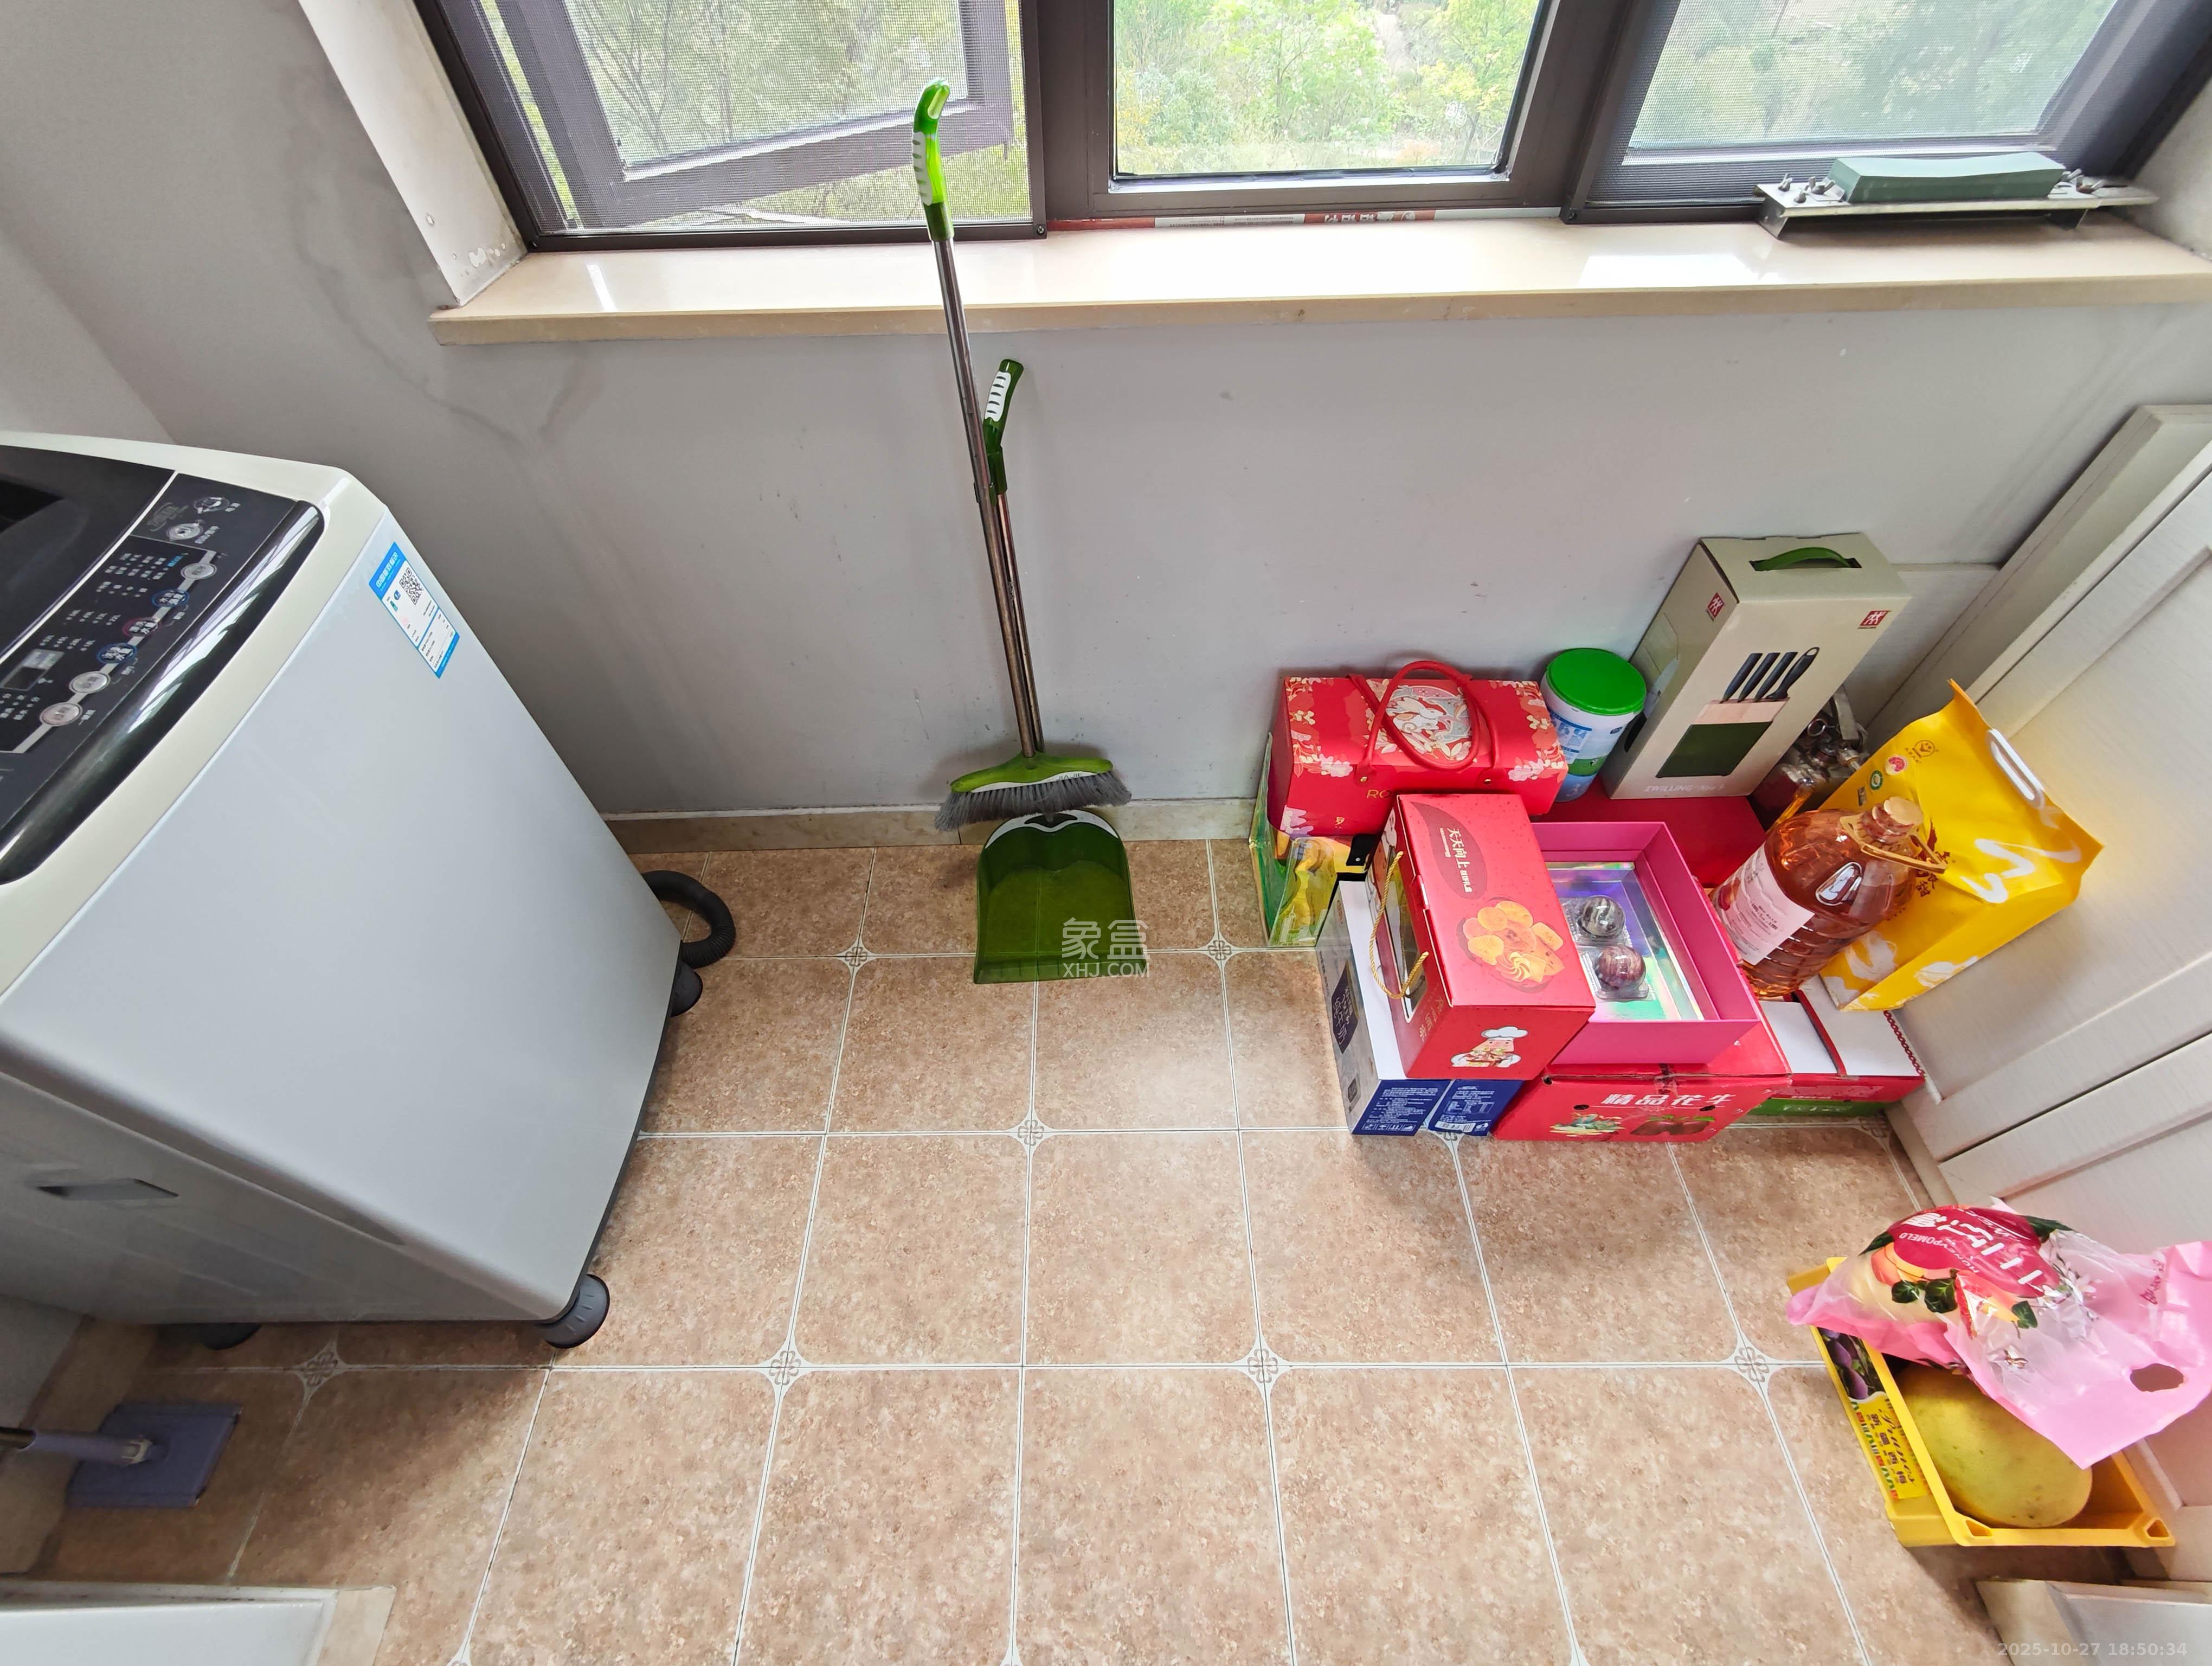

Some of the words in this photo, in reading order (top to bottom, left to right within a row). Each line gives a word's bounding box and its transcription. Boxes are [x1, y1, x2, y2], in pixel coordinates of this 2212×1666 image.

[376, 552, 398, 588] 中国能效标识
[1366, 789, 1390, 798] RO
[1446, 827, 1470, 869] 天天向上
[1600, 1093, 1737, 1105] 精品花牛
[1899, 1232, 1942, 1246] POMELO
